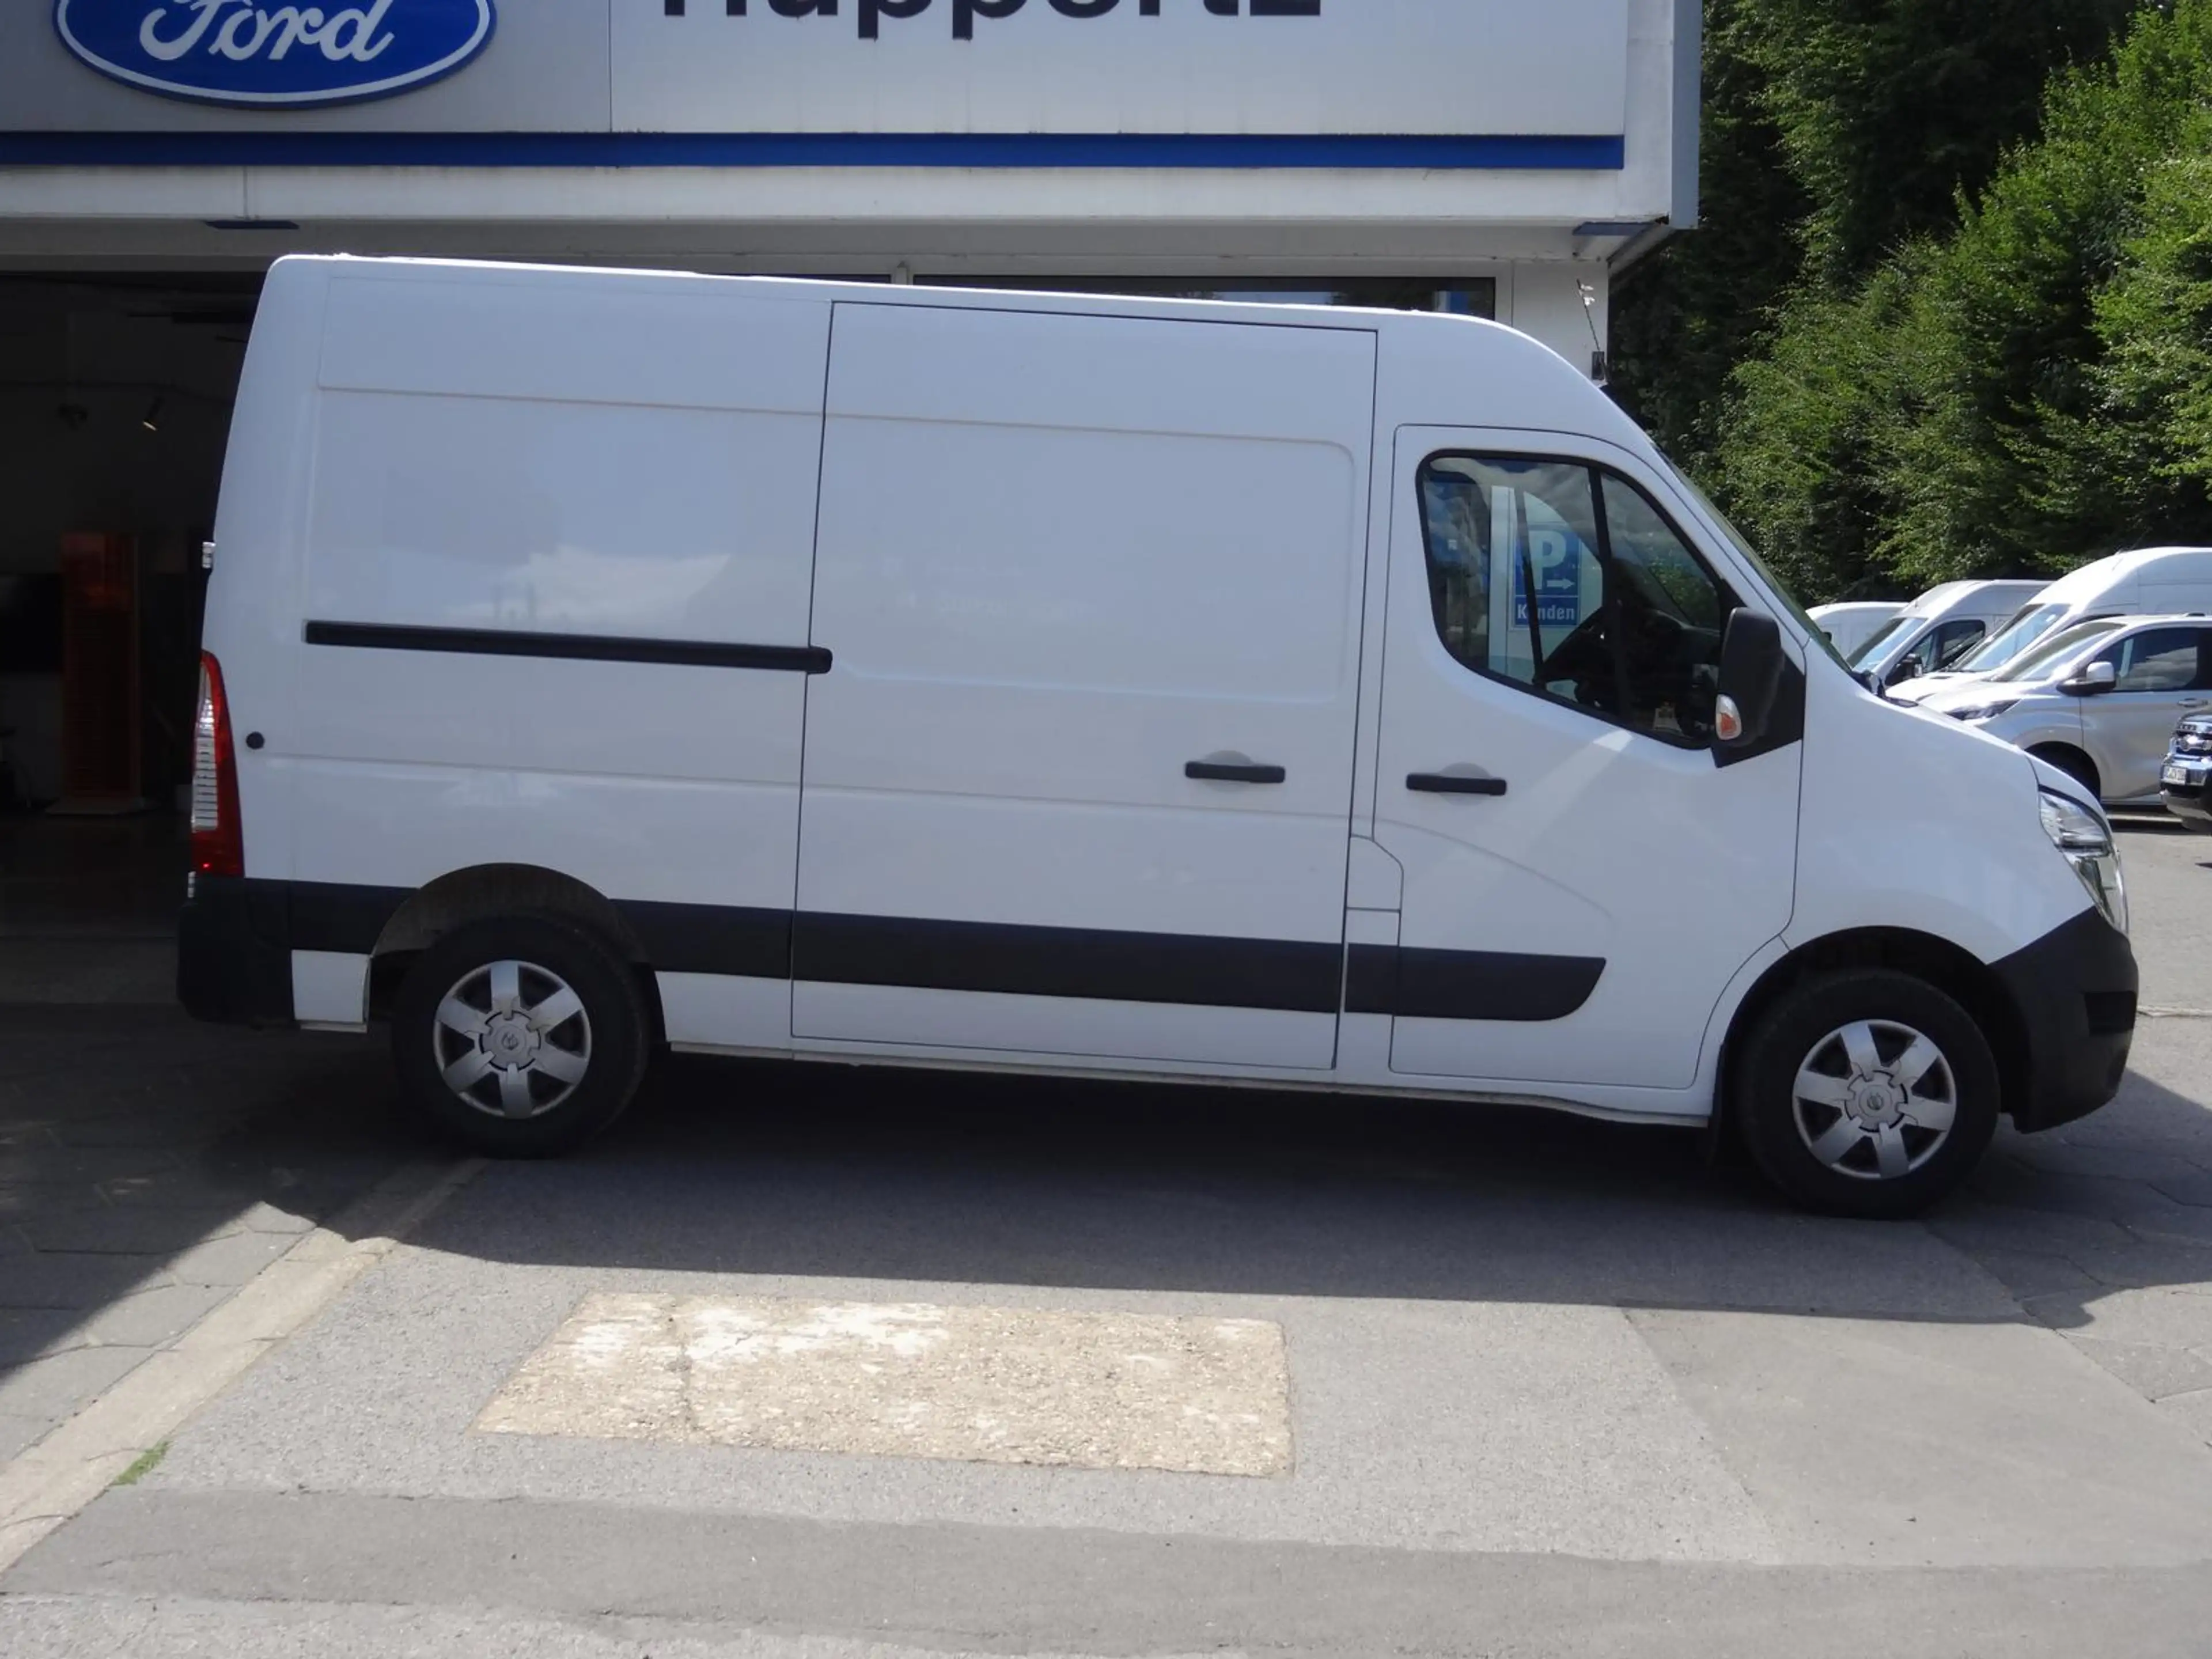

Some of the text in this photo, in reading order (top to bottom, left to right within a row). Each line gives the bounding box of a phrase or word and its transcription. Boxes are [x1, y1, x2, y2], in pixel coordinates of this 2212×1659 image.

[139, 0, 395, 62] Ford
[1528, 530, 1566, 590] P
[1517, 603, 1575, 620] Knden
